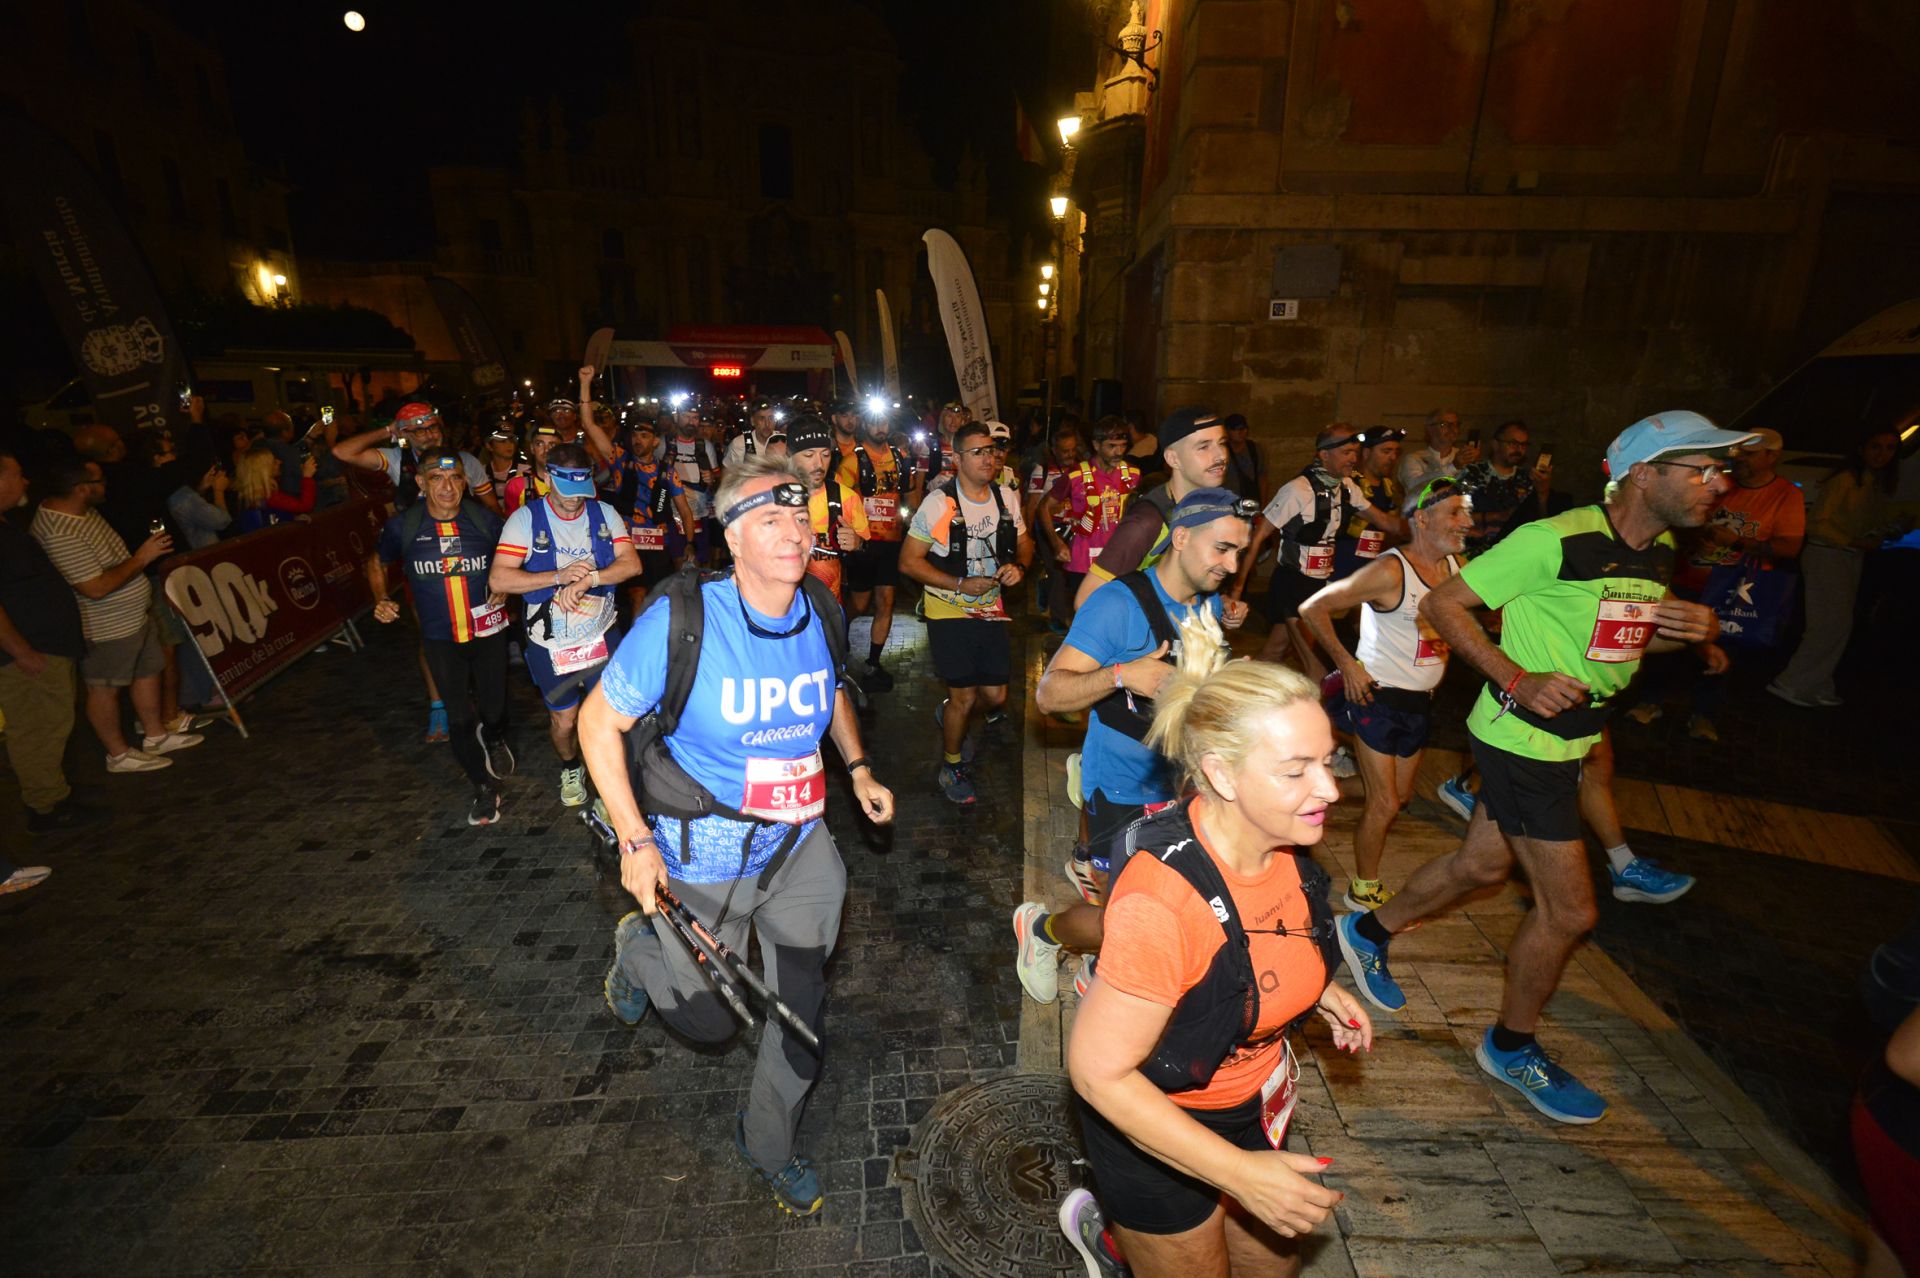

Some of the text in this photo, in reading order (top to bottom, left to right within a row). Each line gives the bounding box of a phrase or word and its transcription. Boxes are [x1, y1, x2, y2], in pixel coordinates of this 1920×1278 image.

[657, 488, 667, 513] KIPRUN
[737, 495, 766, 511] HEADLAMP
[639, 536, 656, 544] 174
[485, 611, 502, 626] 489
[1613, 626, 1644, 644] 419
[251, 648, 266, 665] de
[261, 642, 276, 657] la
[273, 631, 296, 650] cruz
[720, 668, 829, 725] UPCT
[741, 722, 815, 746] CARRERA
[770, 781, 811, 807] 514
[959, 1117, 1002, 1232] AGUAS DE MURCIA
